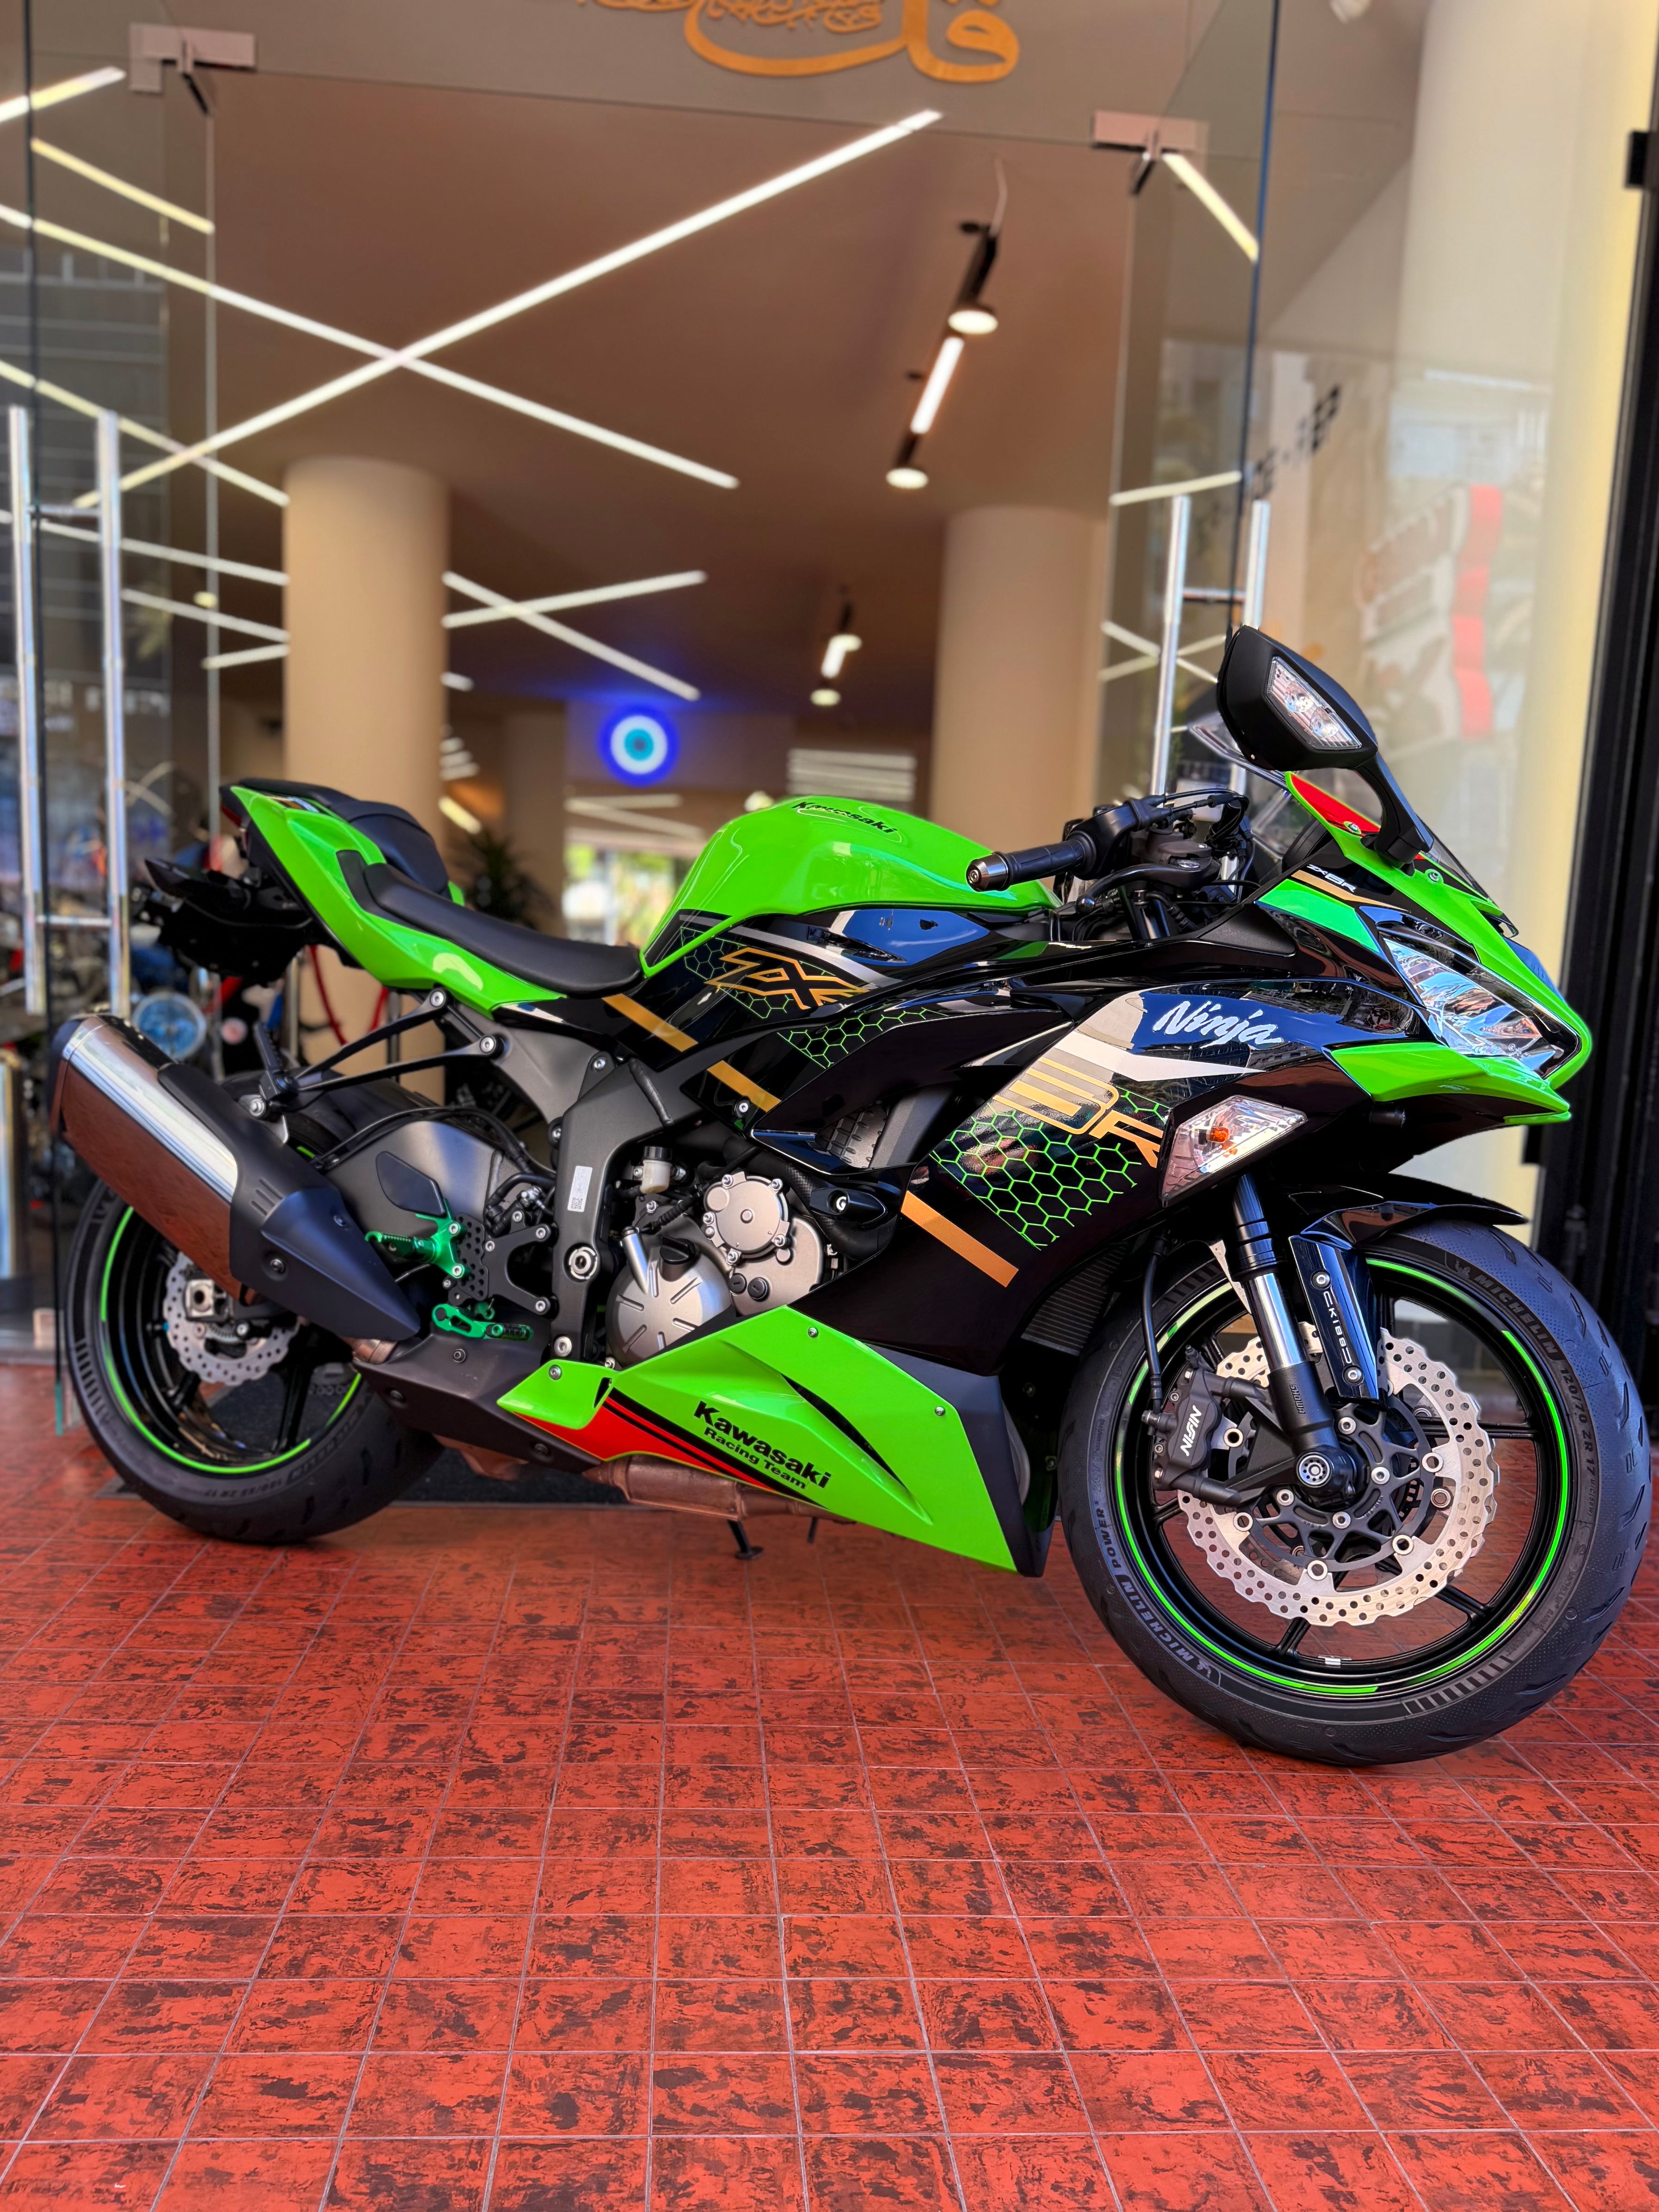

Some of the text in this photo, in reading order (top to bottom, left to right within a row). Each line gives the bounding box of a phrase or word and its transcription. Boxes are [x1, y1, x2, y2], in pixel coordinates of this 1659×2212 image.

[1152, 1001, 1284, 1049] Ninja
[1474, 1274, 1558, 1354] MICHELIN
[1290, 1384, 1306, 1414] SHOWA
[1560, 1368, 1588, 1424] 120/70
[693, 1400, 832, 1489] Kawasaki
[704, 1427, 807, 1490] Racing Team
[1180, 1405, 1202, 1457] NISSIN
[1582, 1430, 1593, 1454] ZR
[1586, 1457, 1596, 1476] 17
[1096, 1508, 1122, 1569] POWER
[1121, 1582, 1194, 1662] MICHELIN
